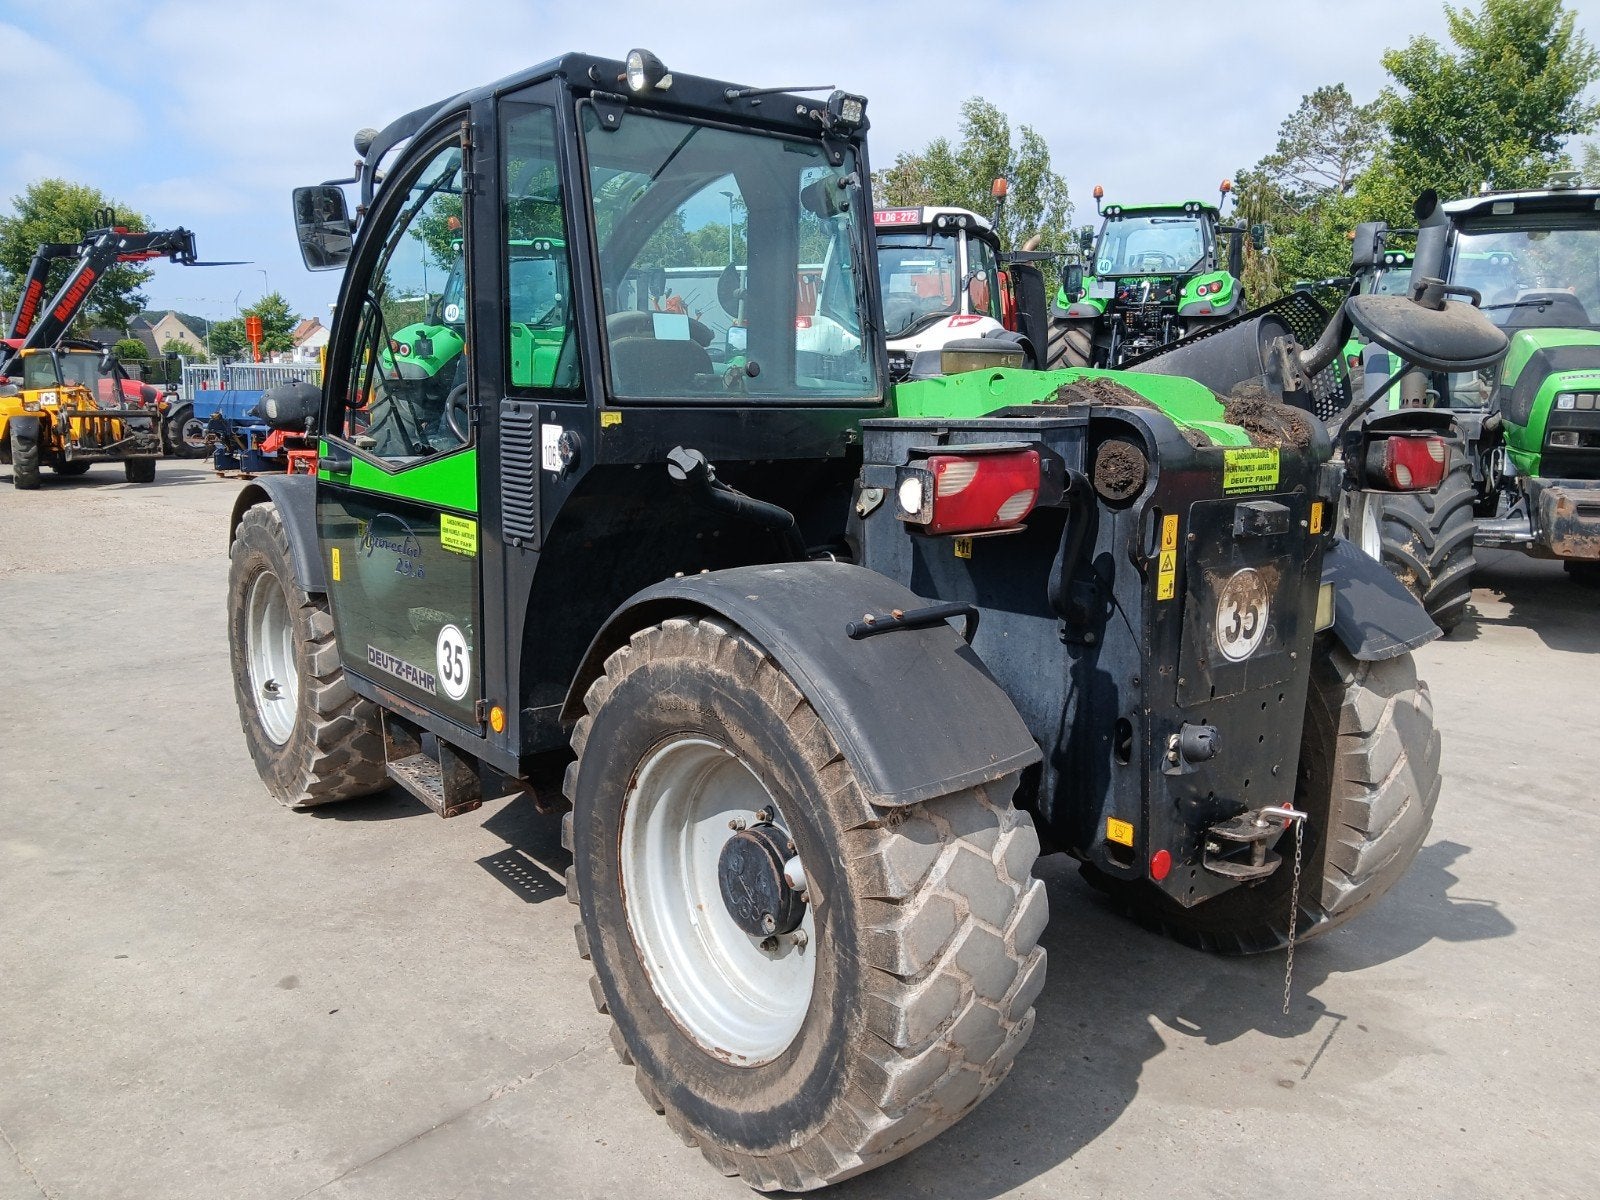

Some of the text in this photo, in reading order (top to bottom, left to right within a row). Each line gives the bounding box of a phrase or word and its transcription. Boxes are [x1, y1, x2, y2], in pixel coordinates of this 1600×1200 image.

[1099, 261, 1110, 272] 40
[15, 279, 42, 335] MANITOU
[53, 266, 95, 322] MANITOU
[447, 306, 457, 319] 40
[544, 444, 557, 467] 106
[1231, 475, 1272, 484] DEUTZ FAHR
[1225, 593, 1261, 643] 35
[368, 646, 435, 692] DEUTZ-FAHR
[442, 640, 464, 685] 35
